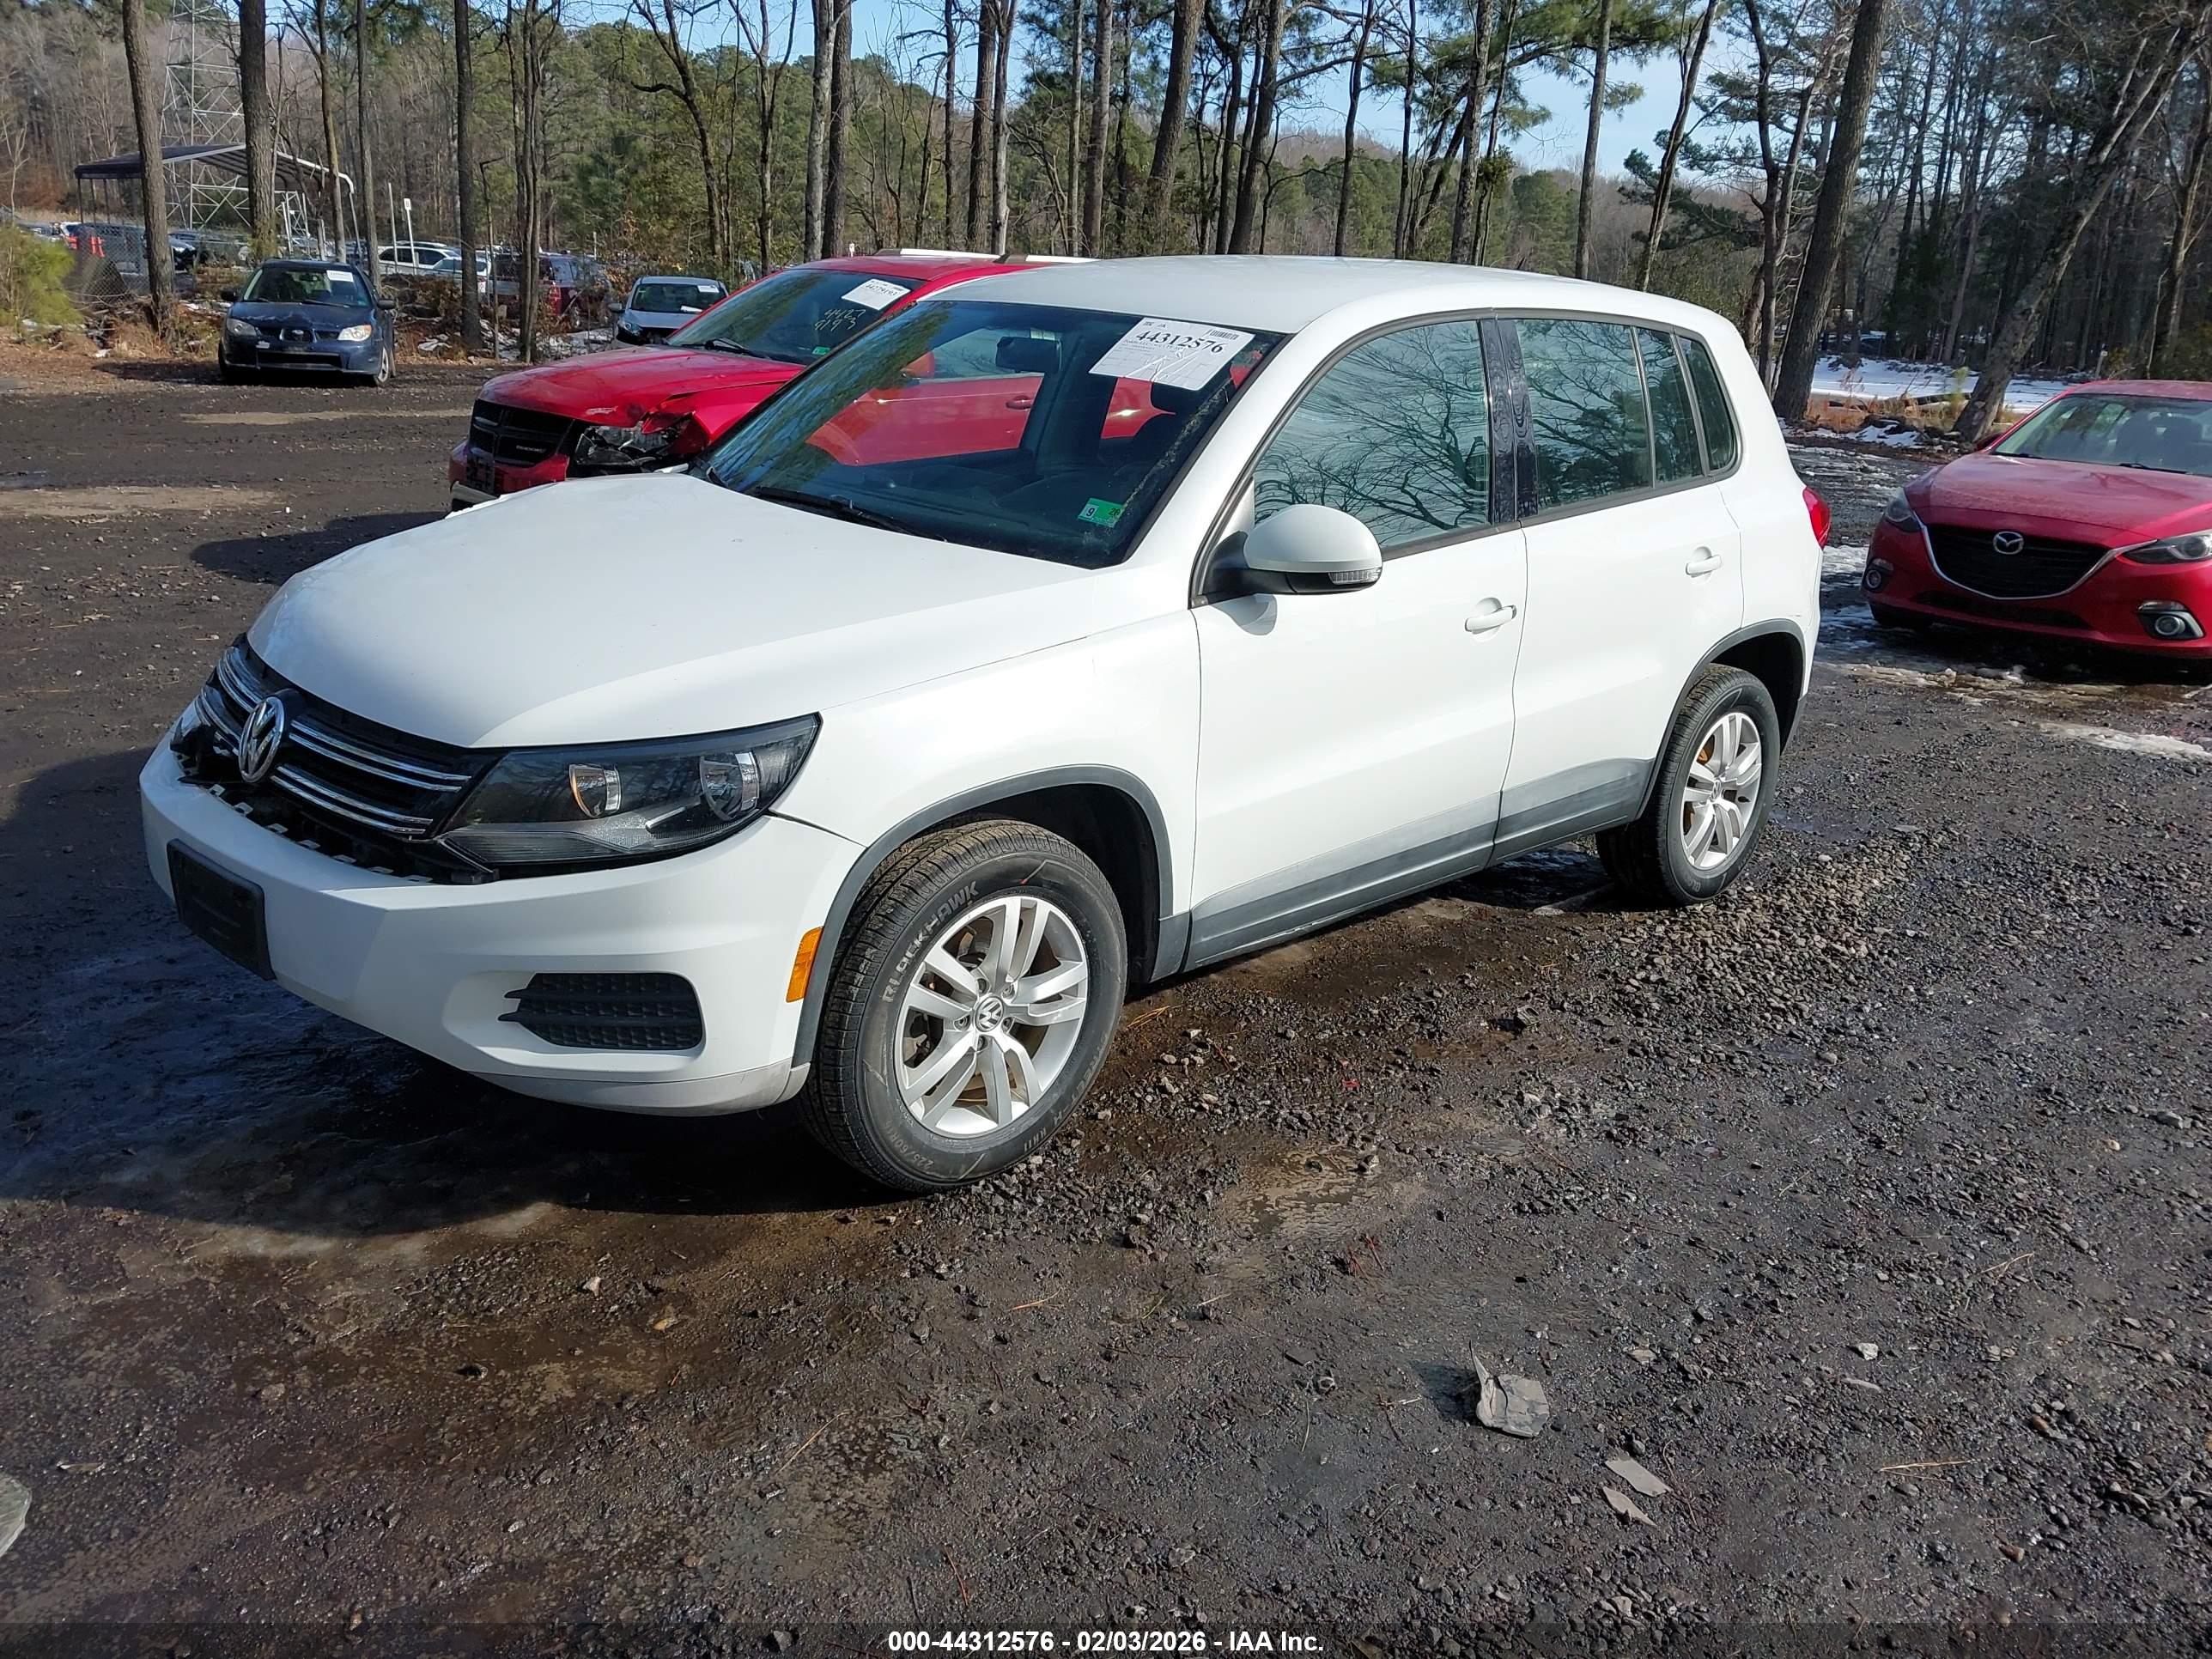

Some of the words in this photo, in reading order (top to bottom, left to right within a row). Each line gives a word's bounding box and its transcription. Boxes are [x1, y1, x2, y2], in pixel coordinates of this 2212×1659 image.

[1134, 331, 1225, 354] 44312576
[1085, 507, 1096, 517] 9
[882, 880, 979, 1004] BLACKHAWK
